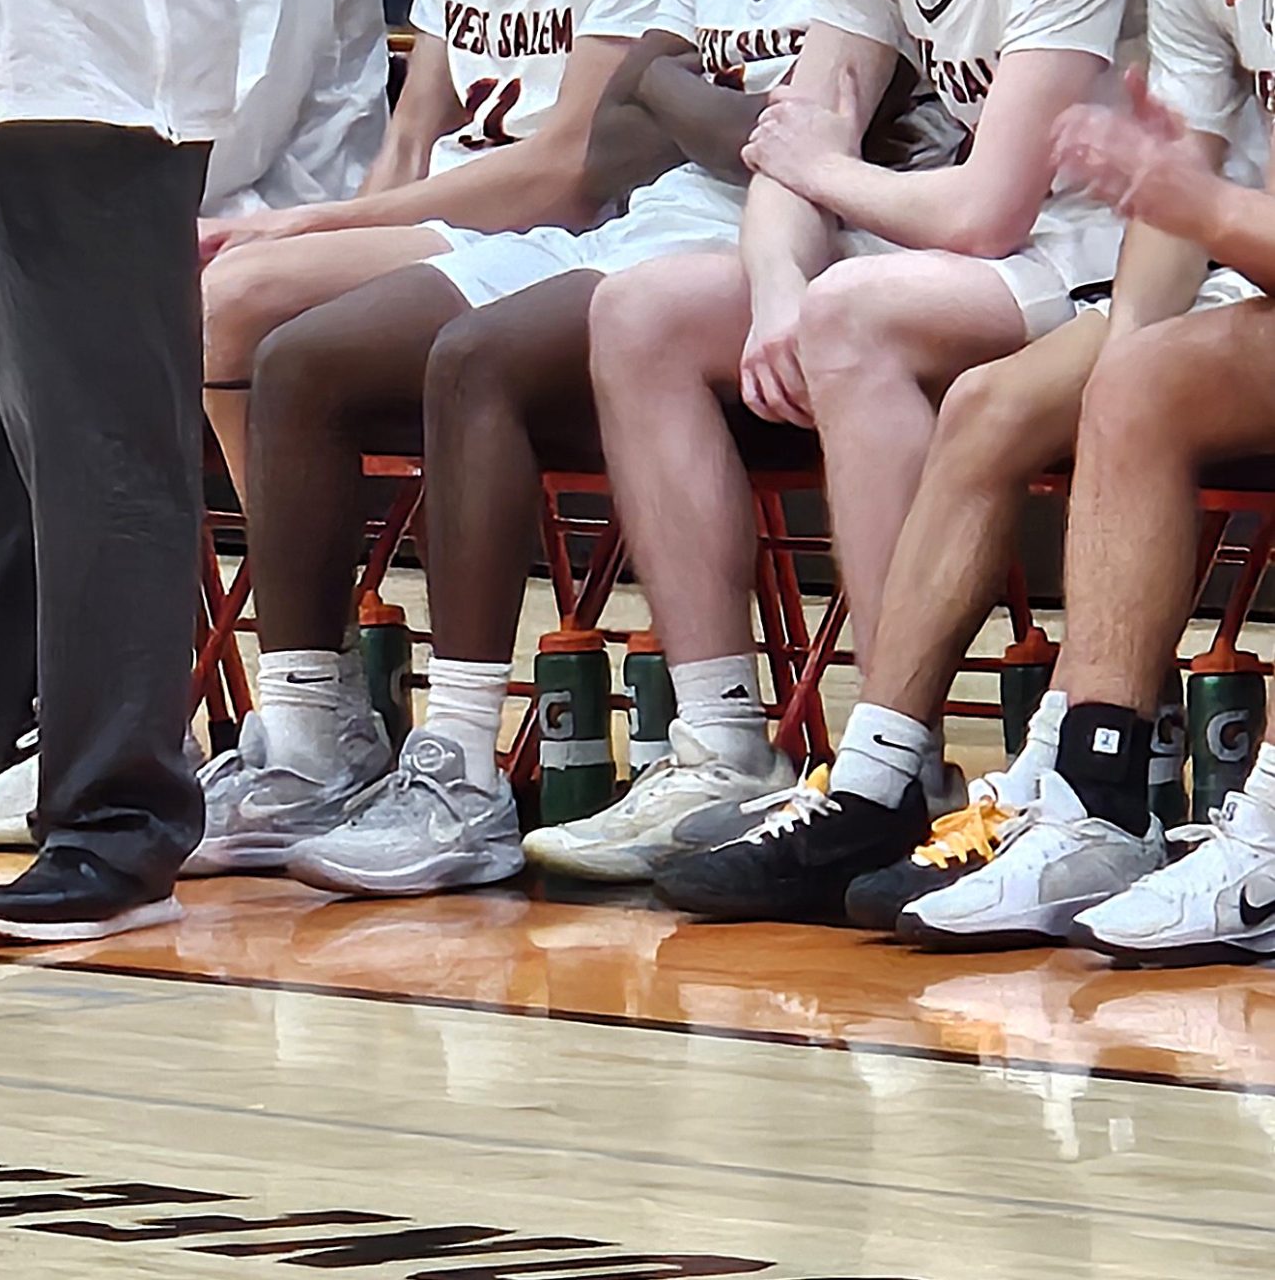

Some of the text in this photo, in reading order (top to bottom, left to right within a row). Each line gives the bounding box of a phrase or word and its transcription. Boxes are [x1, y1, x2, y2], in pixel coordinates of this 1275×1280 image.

[498, 7, 573, 58] SALEM
[538, 690, 574, 739] G
[1206, 708, 1249, 762] G
